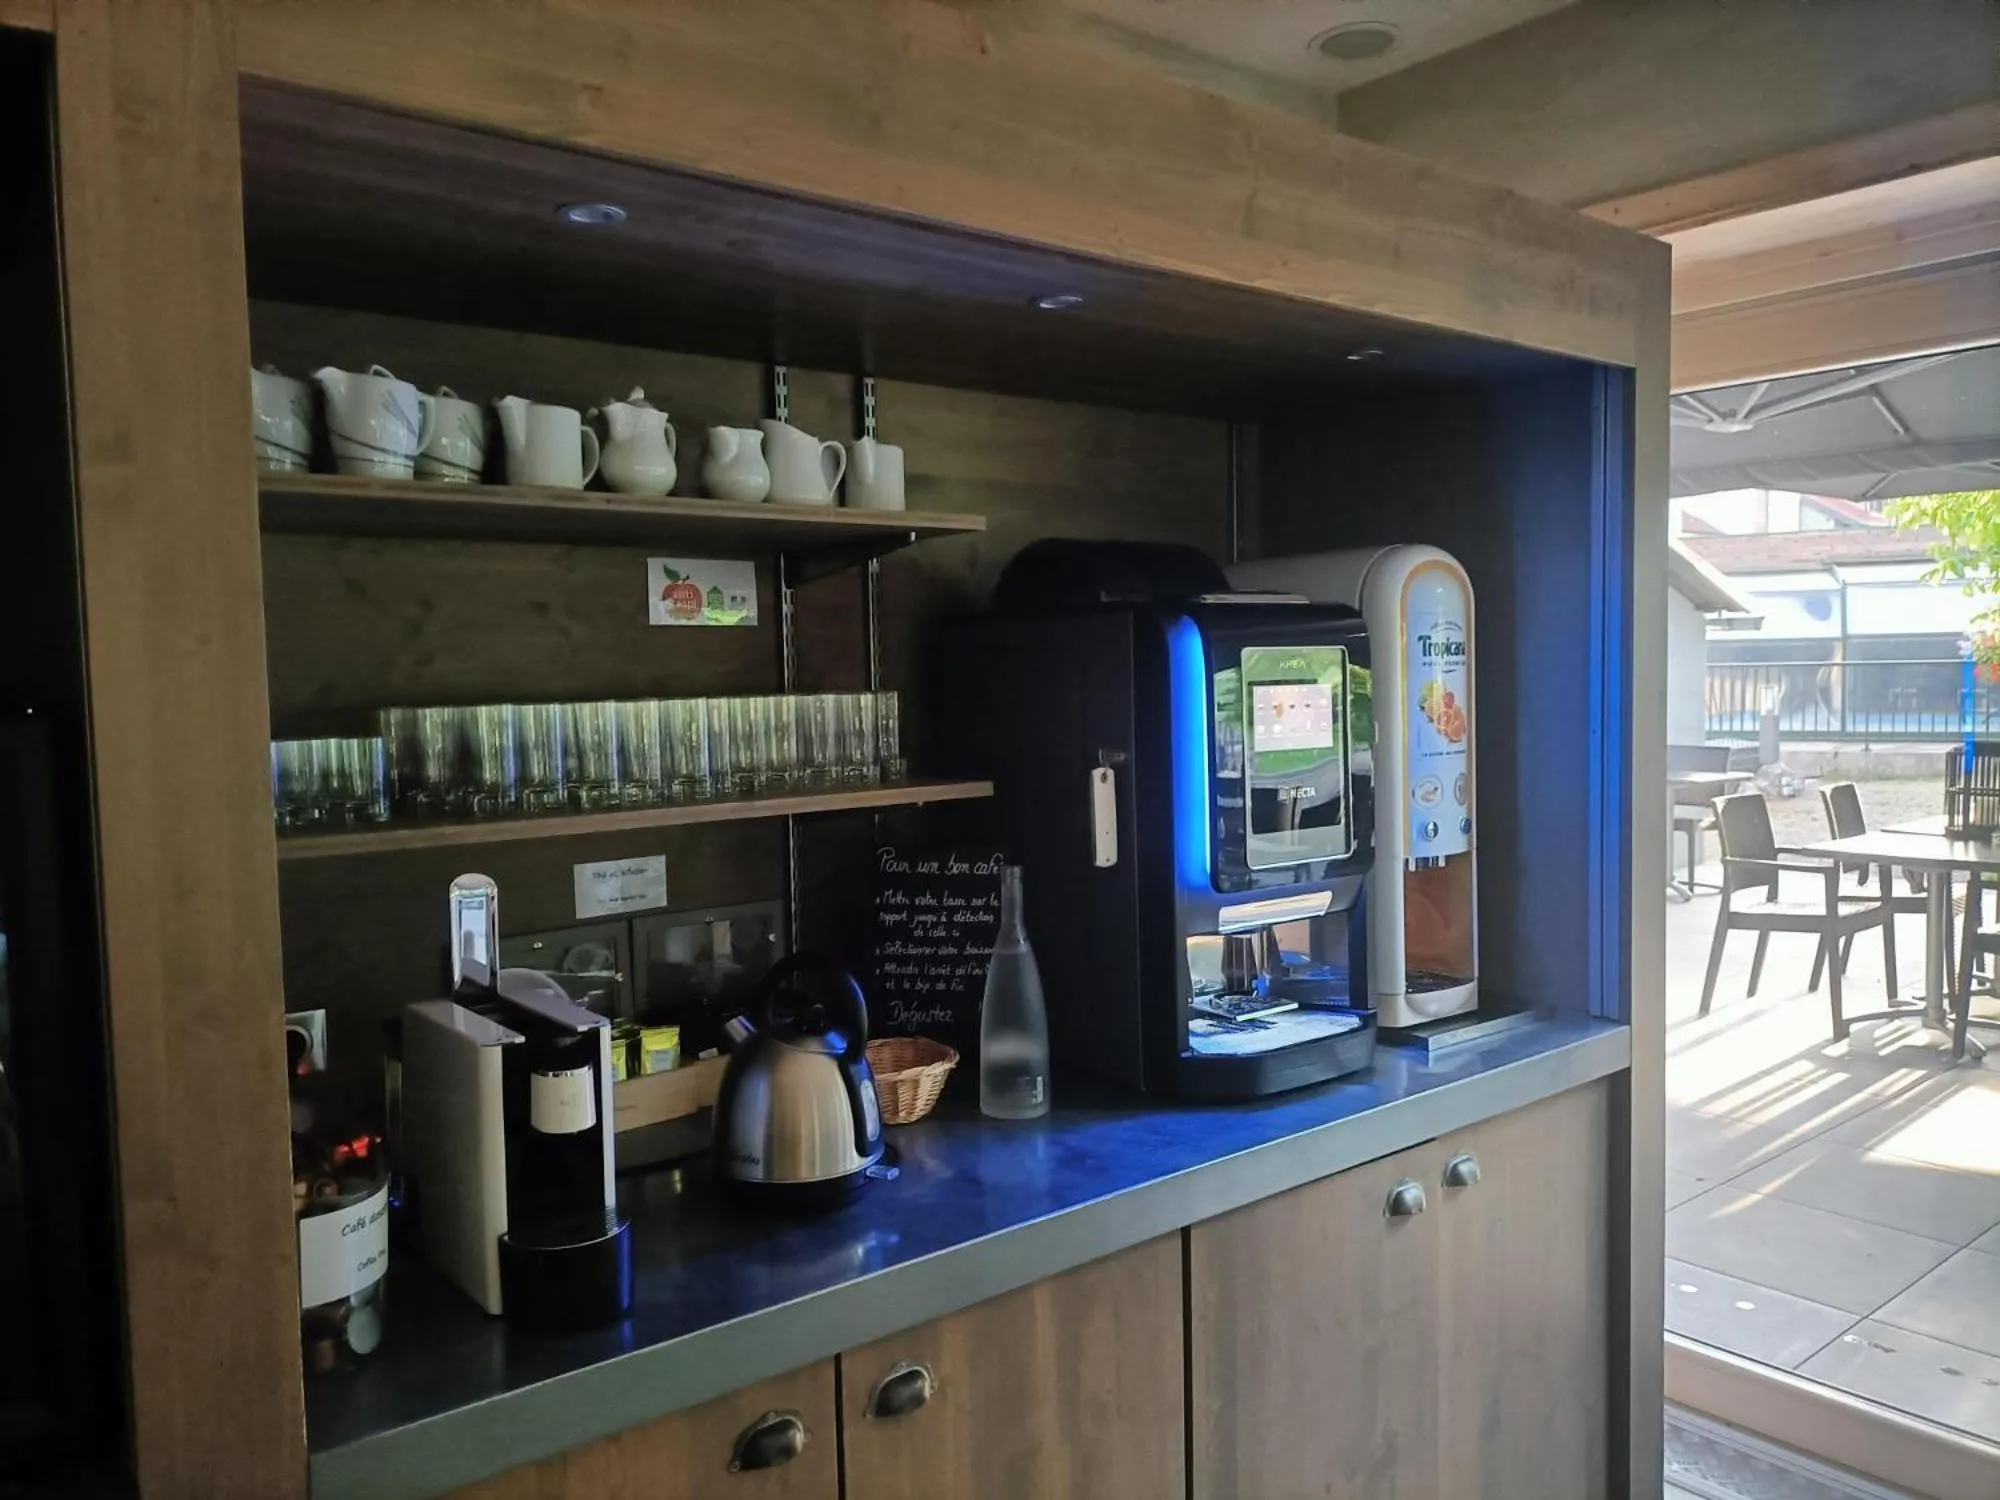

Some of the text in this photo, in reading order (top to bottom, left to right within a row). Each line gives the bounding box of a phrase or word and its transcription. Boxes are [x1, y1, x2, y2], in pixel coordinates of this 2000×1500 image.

[877, 846, 912, 874] Pour
[916, 860, 941, 875] un
[944, 852, 971, 875] bon
[989, 891, 1001, 908] le
